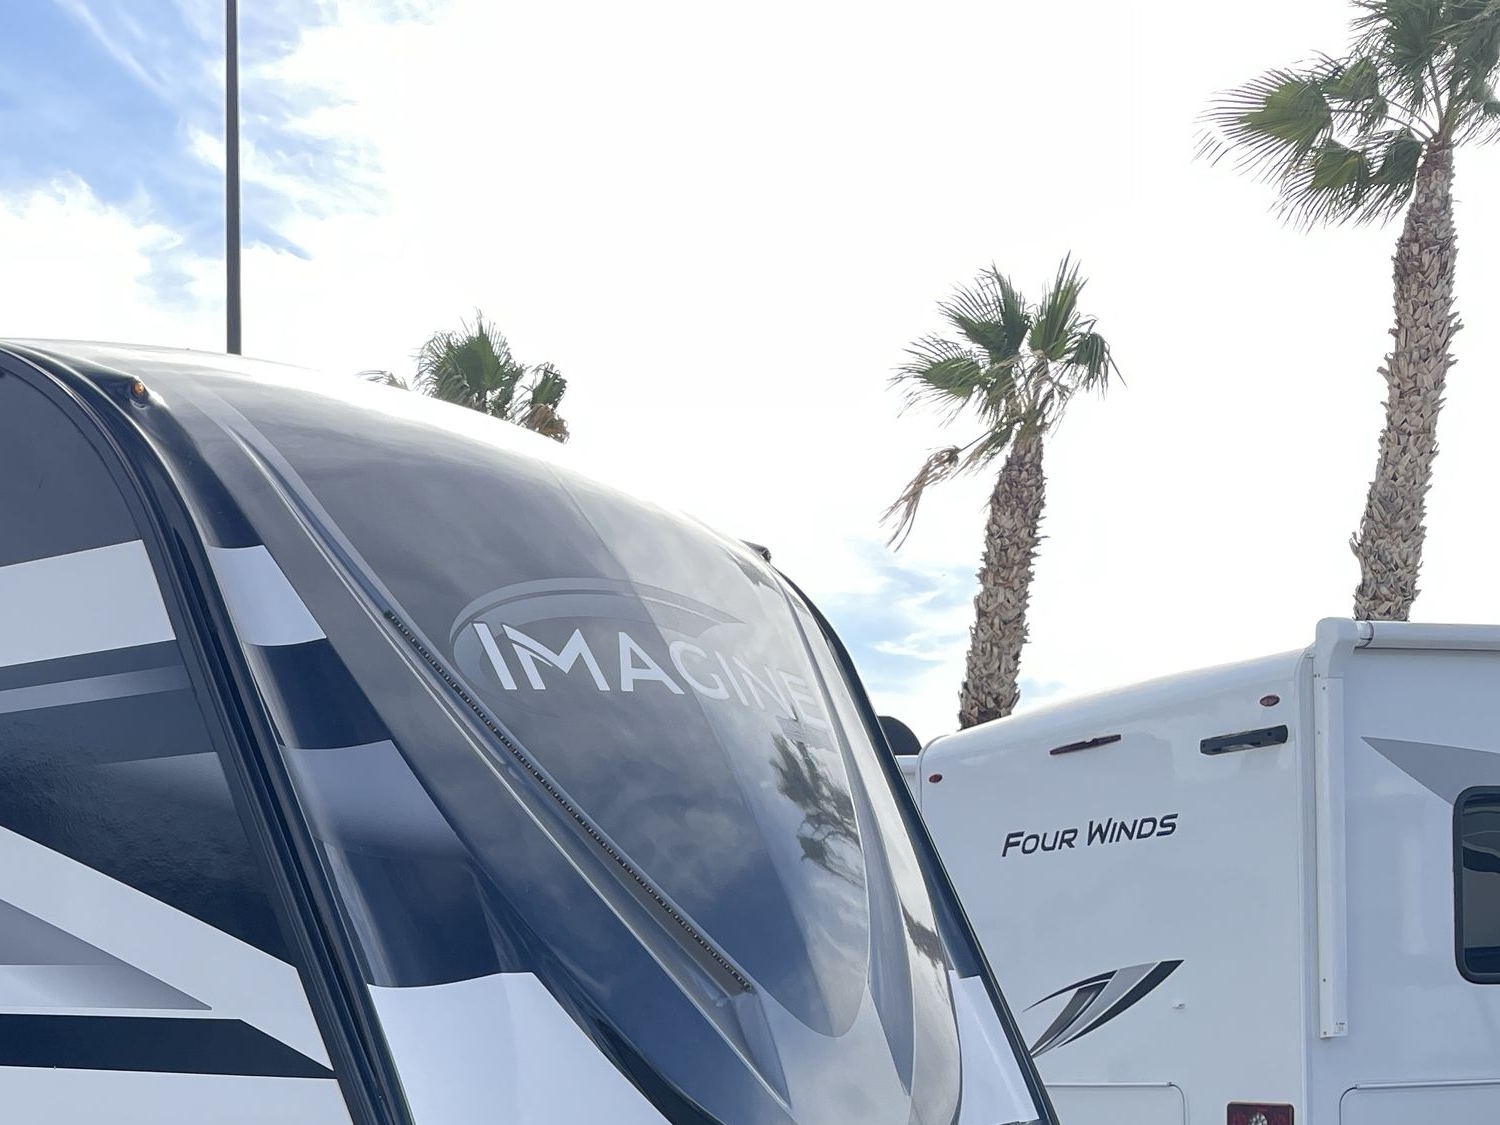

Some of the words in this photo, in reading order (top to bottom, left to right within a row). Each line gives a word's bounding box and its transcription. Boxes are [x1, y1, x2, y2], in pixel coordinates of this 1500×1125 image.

[472, 621, 831, 731] IMAGINE
[1001, 828, 1078, 857] FOUR
[1087, 813, 1179, 847] WINDS
